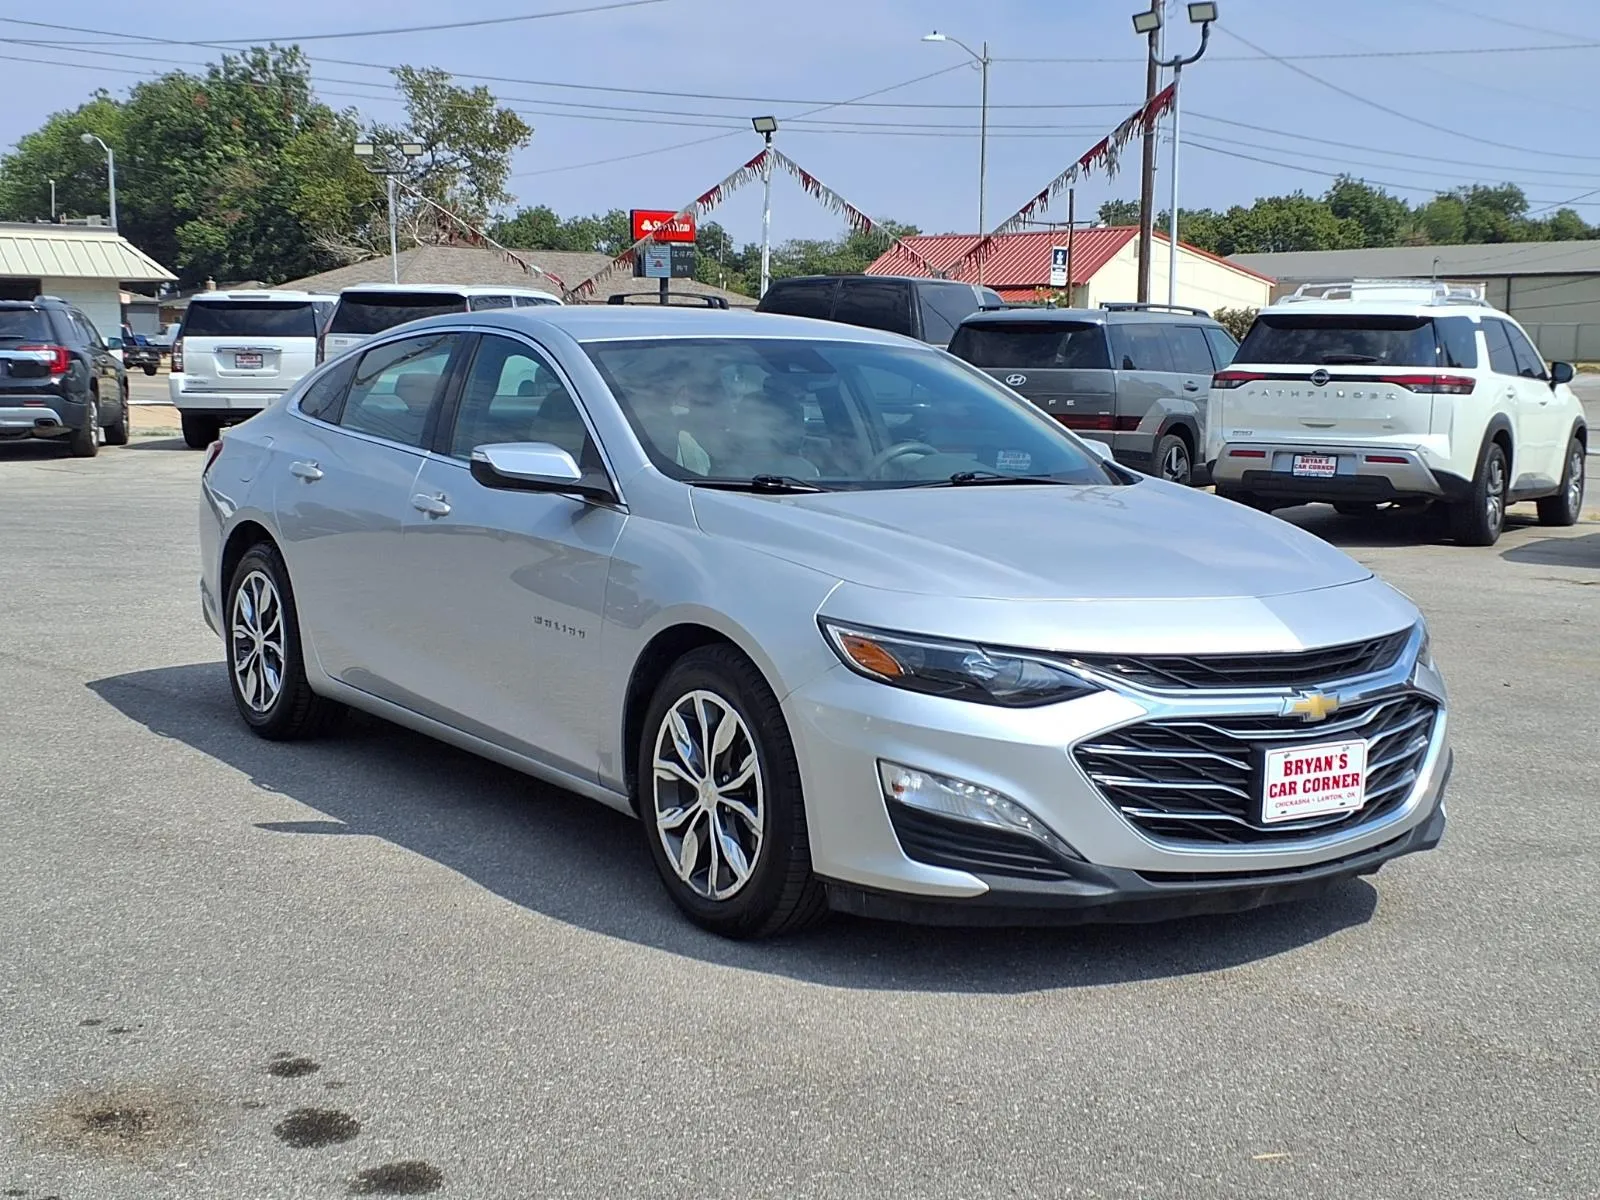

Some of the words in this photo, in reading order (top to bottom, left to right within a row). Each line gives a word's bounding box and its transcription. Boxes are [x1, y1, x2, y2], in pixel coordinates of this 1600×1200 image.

[1247, 389, 1397, 400] PATHFINDER
[1284, 754, 1348, 777] BRYAN'S
[1269, 782, 1297, 798] CAR
[1303, 773, 1360, 794] CORNER
[1275, 798, 1310, 809] CHICKASHA
